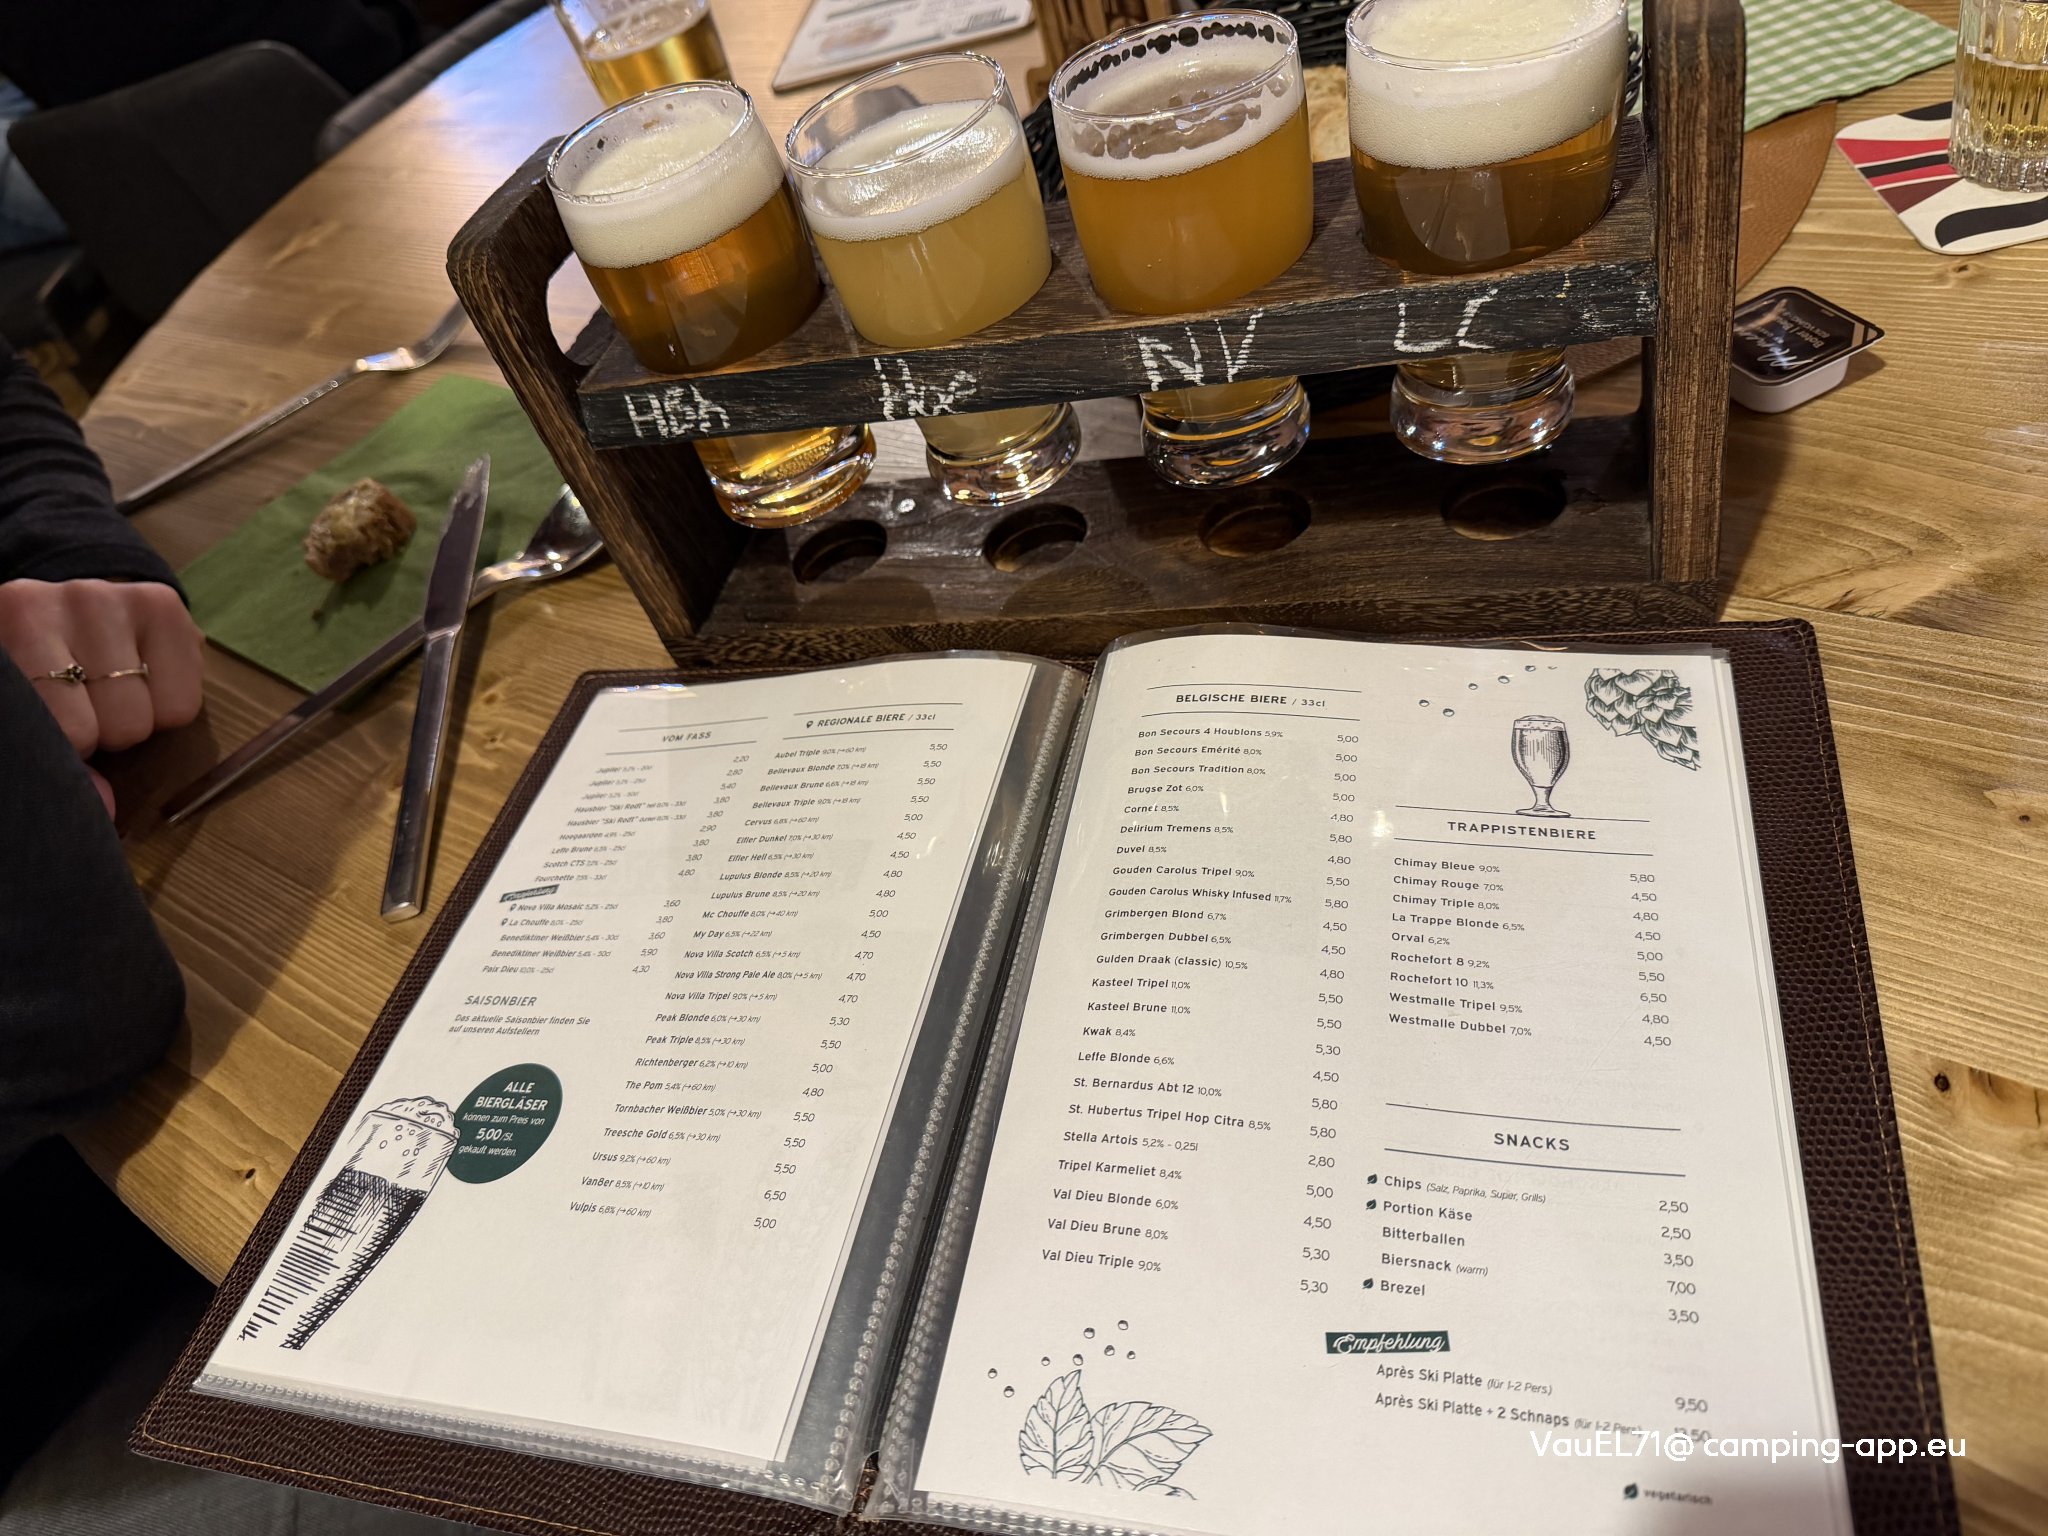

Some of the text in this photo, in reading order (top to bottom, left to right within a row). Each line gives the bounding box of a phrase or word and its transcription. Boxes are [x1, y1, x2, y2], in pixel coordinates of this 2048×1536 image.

[1137, 307, 1263, 392] NV
[1175, 693, 1326, 708] BELGISCHE BIERE / 33cl
[816, 715, 874, 728] REGIONALE
[875, 713, 906, 723] BIERE
[915, 713, 936, 721] 33cl
[662, 730, 712, 743] VOM FASS
[1138, 727, 1359, 744] Bon Secours 4 Houblons 5,9% 5,00
[767, 760, 943, 776] Bellevaux Blonde 5,50
[1119, 824, 1353, 844] Delirium Tremens 8,5% 5,80
[1447, 821, 1597, 840] TRAPPISTENBIERE
[719, 872, 752, 882] Lupulus
[753, 870, 783, 879] Blonde
[882, 870, 903, 878] 4,80
[1112, 865, 1350, 887] Gouden Carolus Tripel 9,0% 5,50
[1393, 857, 1656, 884] Chimay Bleue 9,0% 5,80
[499, 933, 550, 942] Benediktiner
[647, 931, 666, 941] 3,60
[1392, 912, 1661, 942] La Trappe Blonde 6,5% 4,50
[1391, 932, 1664, 963] Orval 6,2% 5,00
[631, 964, 651, 974] 4,30
[664, 992, 686, 1000] Nova
[688, 991, 706, 1000] Villa
[707, 991, 732, 1002] Tripel
[838, 994, 859, 1004] 4,70
[1390, 971, 1452, 986] Rochefort
[1455, 977, 1469, 988] 10
[1639, 992, 1668, 1004] 6,50
[463, 995, 538, 1007] SAISONBIER
[1389, 992, 1670, 1026] Westmalle Tripel 9,5% 4,80
[454, 1013, 591, 1025] Das aktuelle Saisonbier finden Sie
[448, 1024, 541, 1036] auf unseren Aufstellern
[645, 1035, 668, 1044] Peak
[669, 1035, 694, 1046] Triple
[819, 1039, 842, 1050] 5,50
[1082, 1026, 1341, 1056] Kwak 8,4% 5,30
[634, 1057, 700, 1069] Richtenberger
[811, 1062, 834, 1074] 5,00
[503, 1081, 536, 1094] ALLE
[474, 1095, 549, 1111] BIERGLÄSER
[614, 1103, 666, 1114] Tornbacher
[667, 1105, 709, 1116] Weißbier
[792, 1111, 816, 1123] 5,50
[462, 1112, 546, 1126] können zum Preis von
[1067, 1103, 1337, 1139] St. Hubertus Tripel Hop Citra 8,5% 5,80
[603, 1127, 644, 1138] Treesche
[646, 1129, 669, 1139] Gold
[783, 1137, 806, 1149] 5,50
[1493, 1132, 1570, 1152] SNACKS
[458, 1144, 488, 1155] gekauft
[1063, 1131, 1098, 1143] Stella
[1100, 1133, 1138, 1146] Artois
[1141, 1137, 1165, 1149] 5,2%
[1307, 1154, 1336, 1168] 2,80
[592, 1151, 619, 1162] Ursus
[773, 1162, 797, 1175] 5,50
[1384, 1175, 1422, 1191] Chips
[1451, 1185, 1487, 1199] Paprika,
[1521, 1192, 1547, 1205] Grills)
[1658, 1200, 1689, 1214] 2,50
[569, 1201, 598, 1214] Vulpis
[753, 1216, 777, 1230] 5,00
[1053, 1188, 1332, 1230] Val Dieu Blonde 6,0% 4,50
[1383, 1200, 1692, 1241] Portion Käse 2,50
[1382, 1226, 1694, 1268] Bitterballen 3,50
[1381, 1252, 1697, 1296] Biersnack (warm) 7,00
[1380, 1279, 1700, 1325] Brezel 3,50
[1332, 1331, 1446, 1354] Empfehlung
[1376, 1363, 1415, 1380] Après
[1418, 1368, 1439, 1383] Ski
[1442, 1371, 1483, 1387] Platte
[1486, 1378, 1505, 1391] (für
[1674, 1396, 1709, 1414] 9,50
